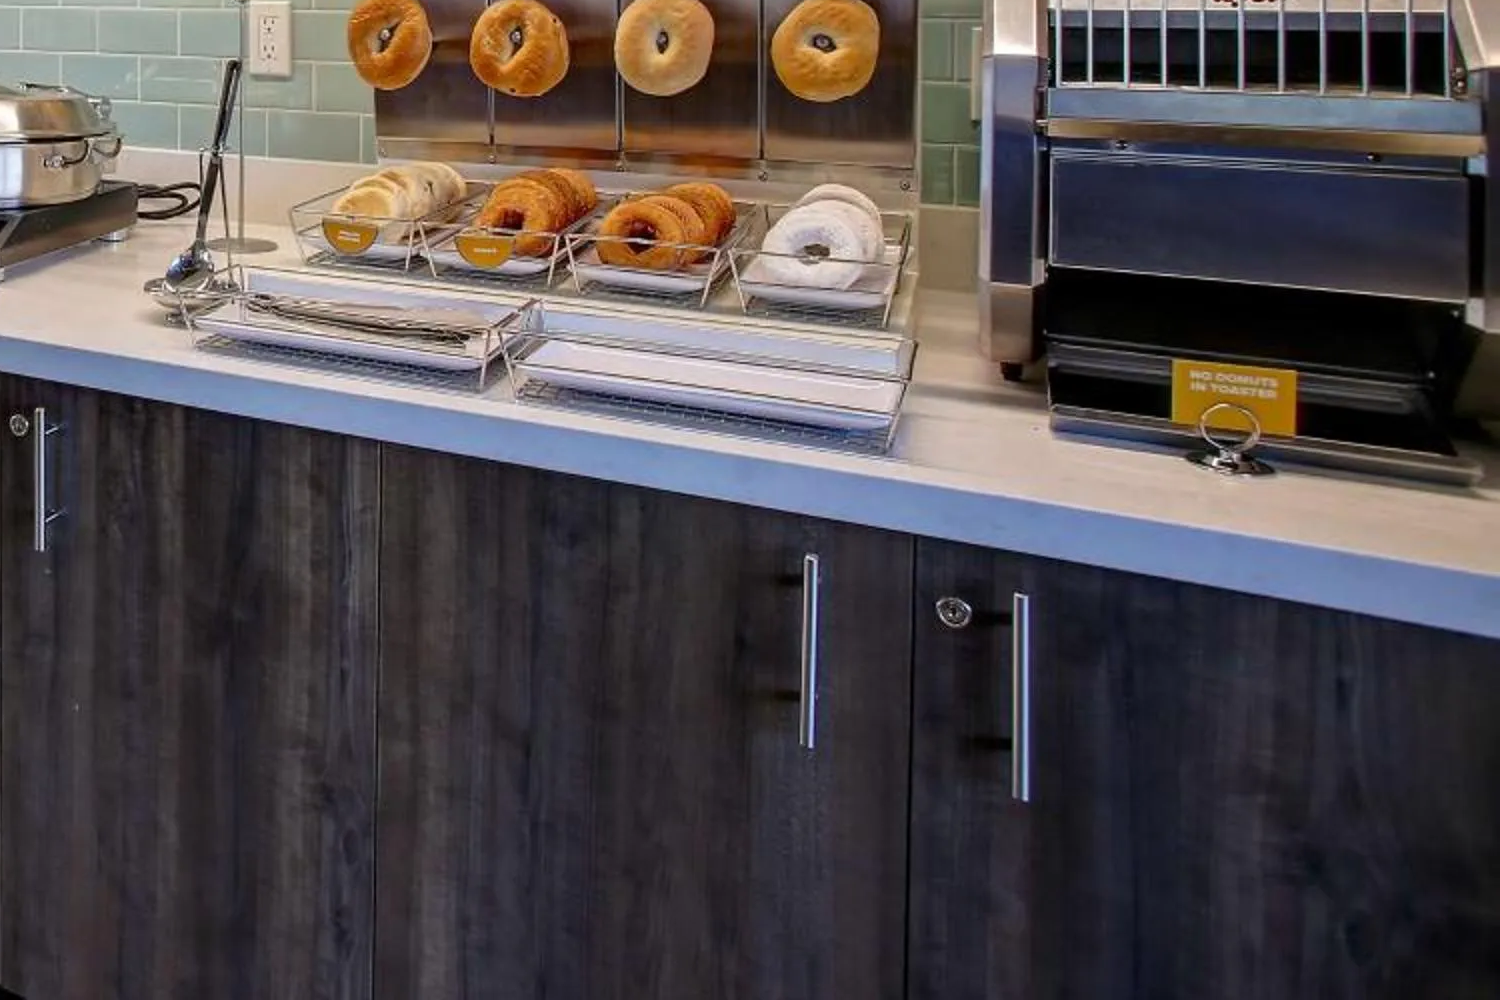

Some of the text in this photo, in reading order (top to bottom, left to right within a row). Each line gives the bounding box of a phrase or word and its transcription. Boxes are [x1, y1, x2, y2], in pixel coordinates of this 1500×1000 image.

[1189, 370, 1278, 388] NO DONUTS
[1189, 382, 1277, 398] IN TOASTER
